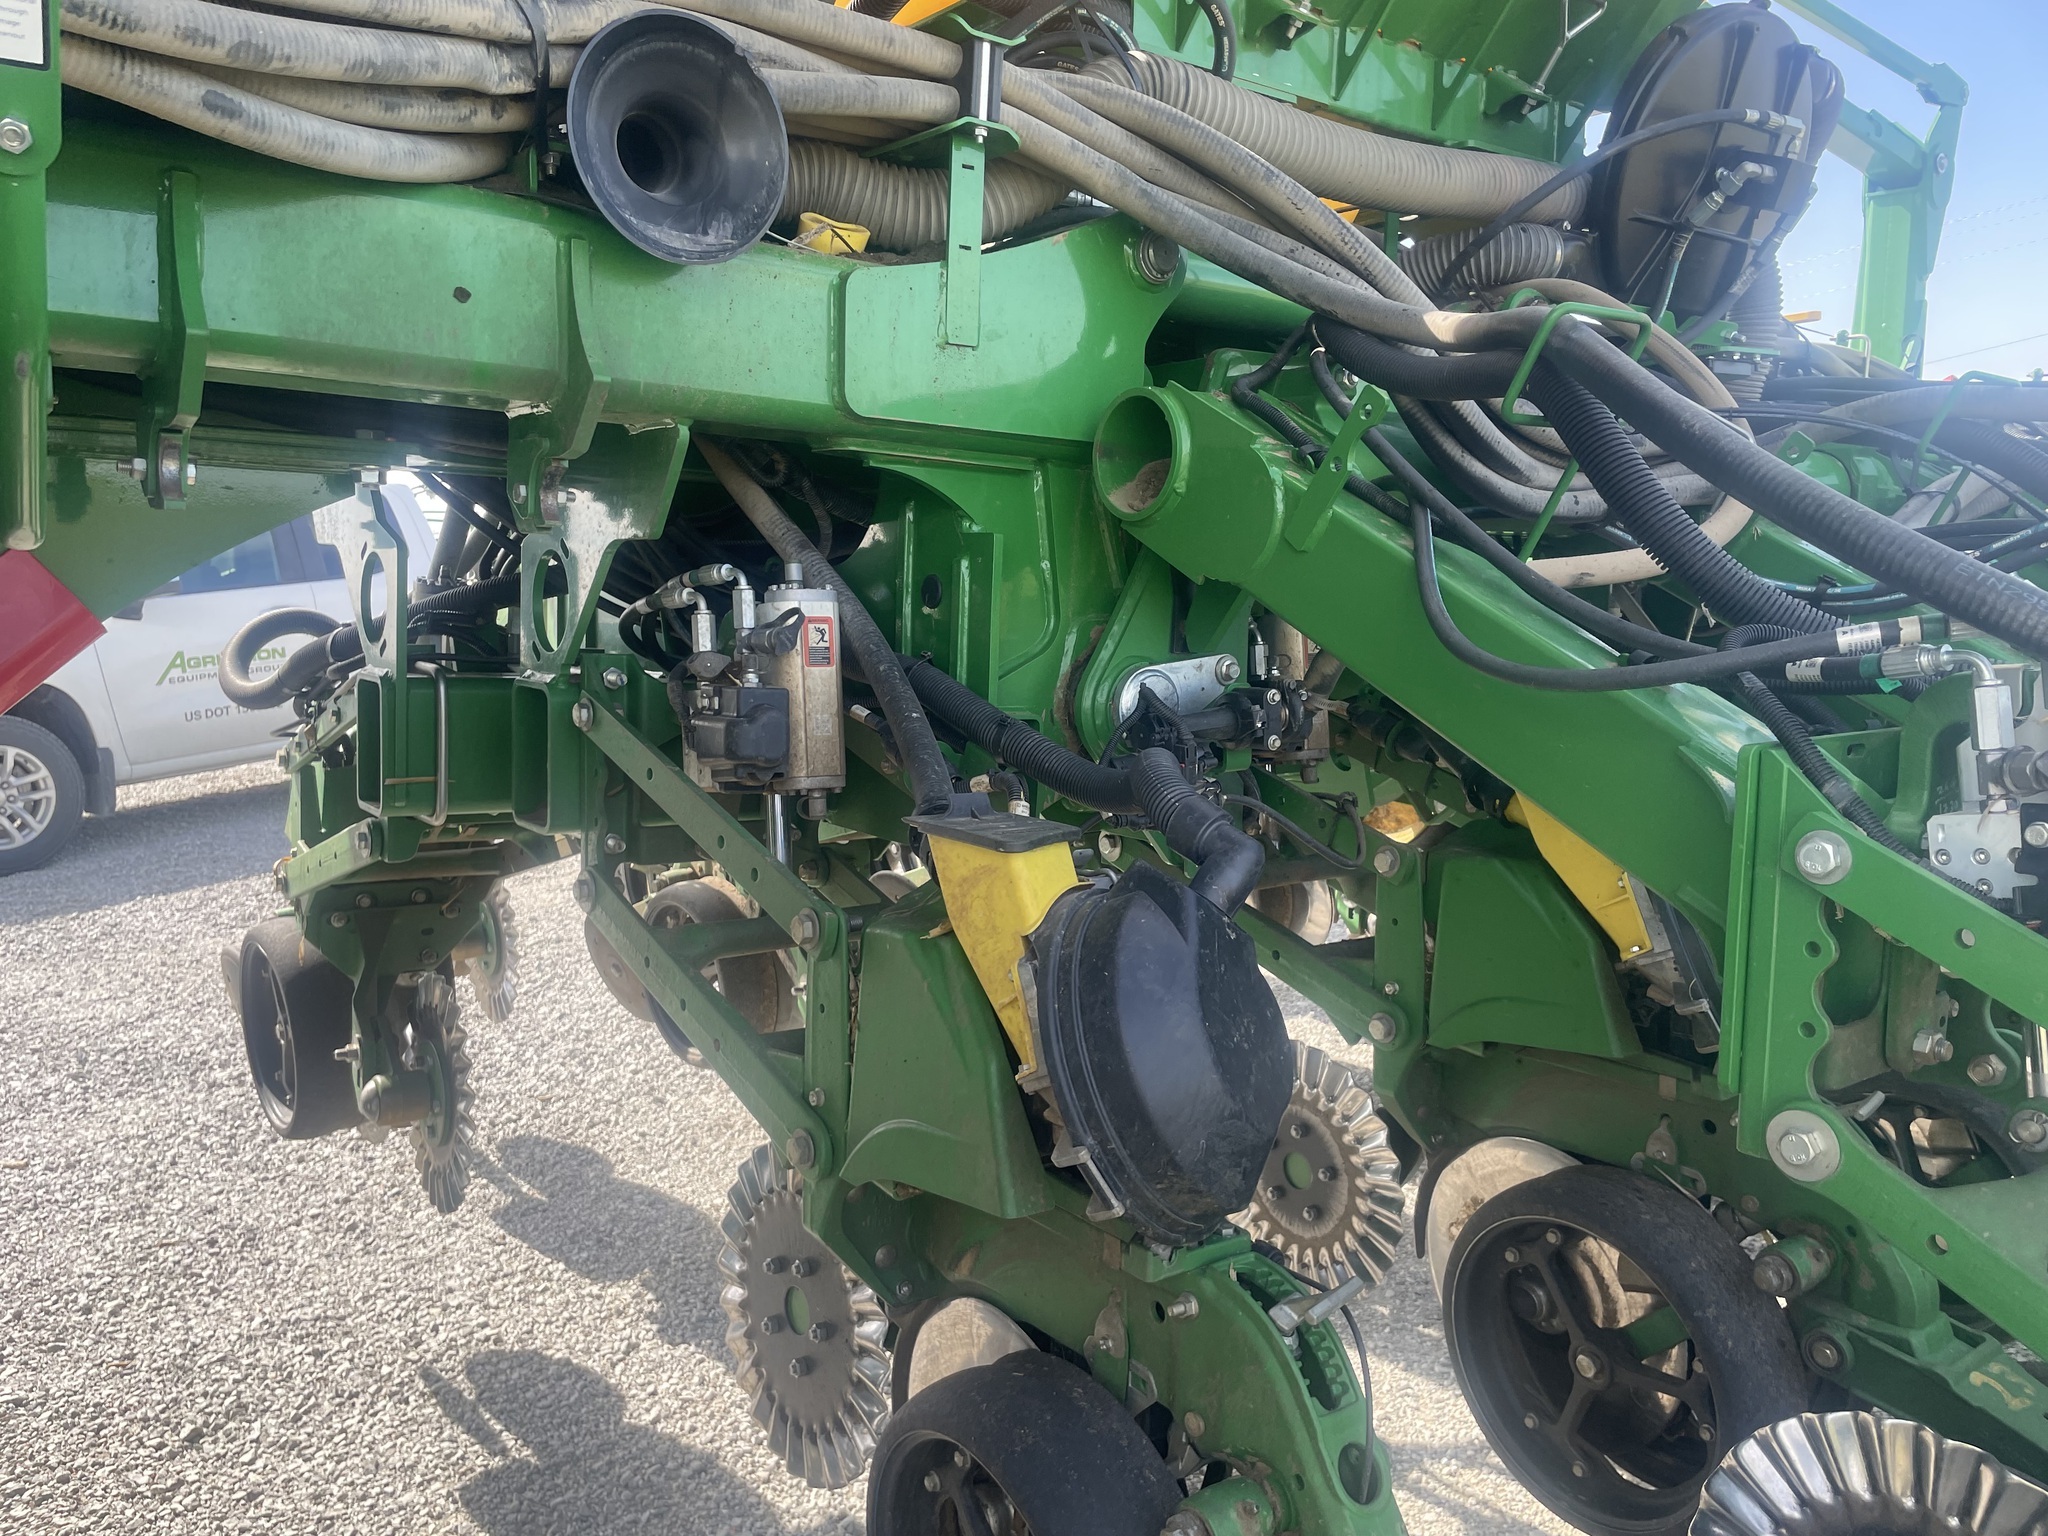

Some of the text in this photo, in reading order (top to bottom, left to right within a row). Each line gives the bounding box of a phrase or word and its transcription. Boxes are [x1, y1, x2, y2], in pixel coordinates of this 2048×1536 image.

[1210, 4, 1225, 27] GATES
[168, 672, 218, 684] EQUIPM
[184, 710, 202, 722] US
[205, 705, 231, 719] DOT
